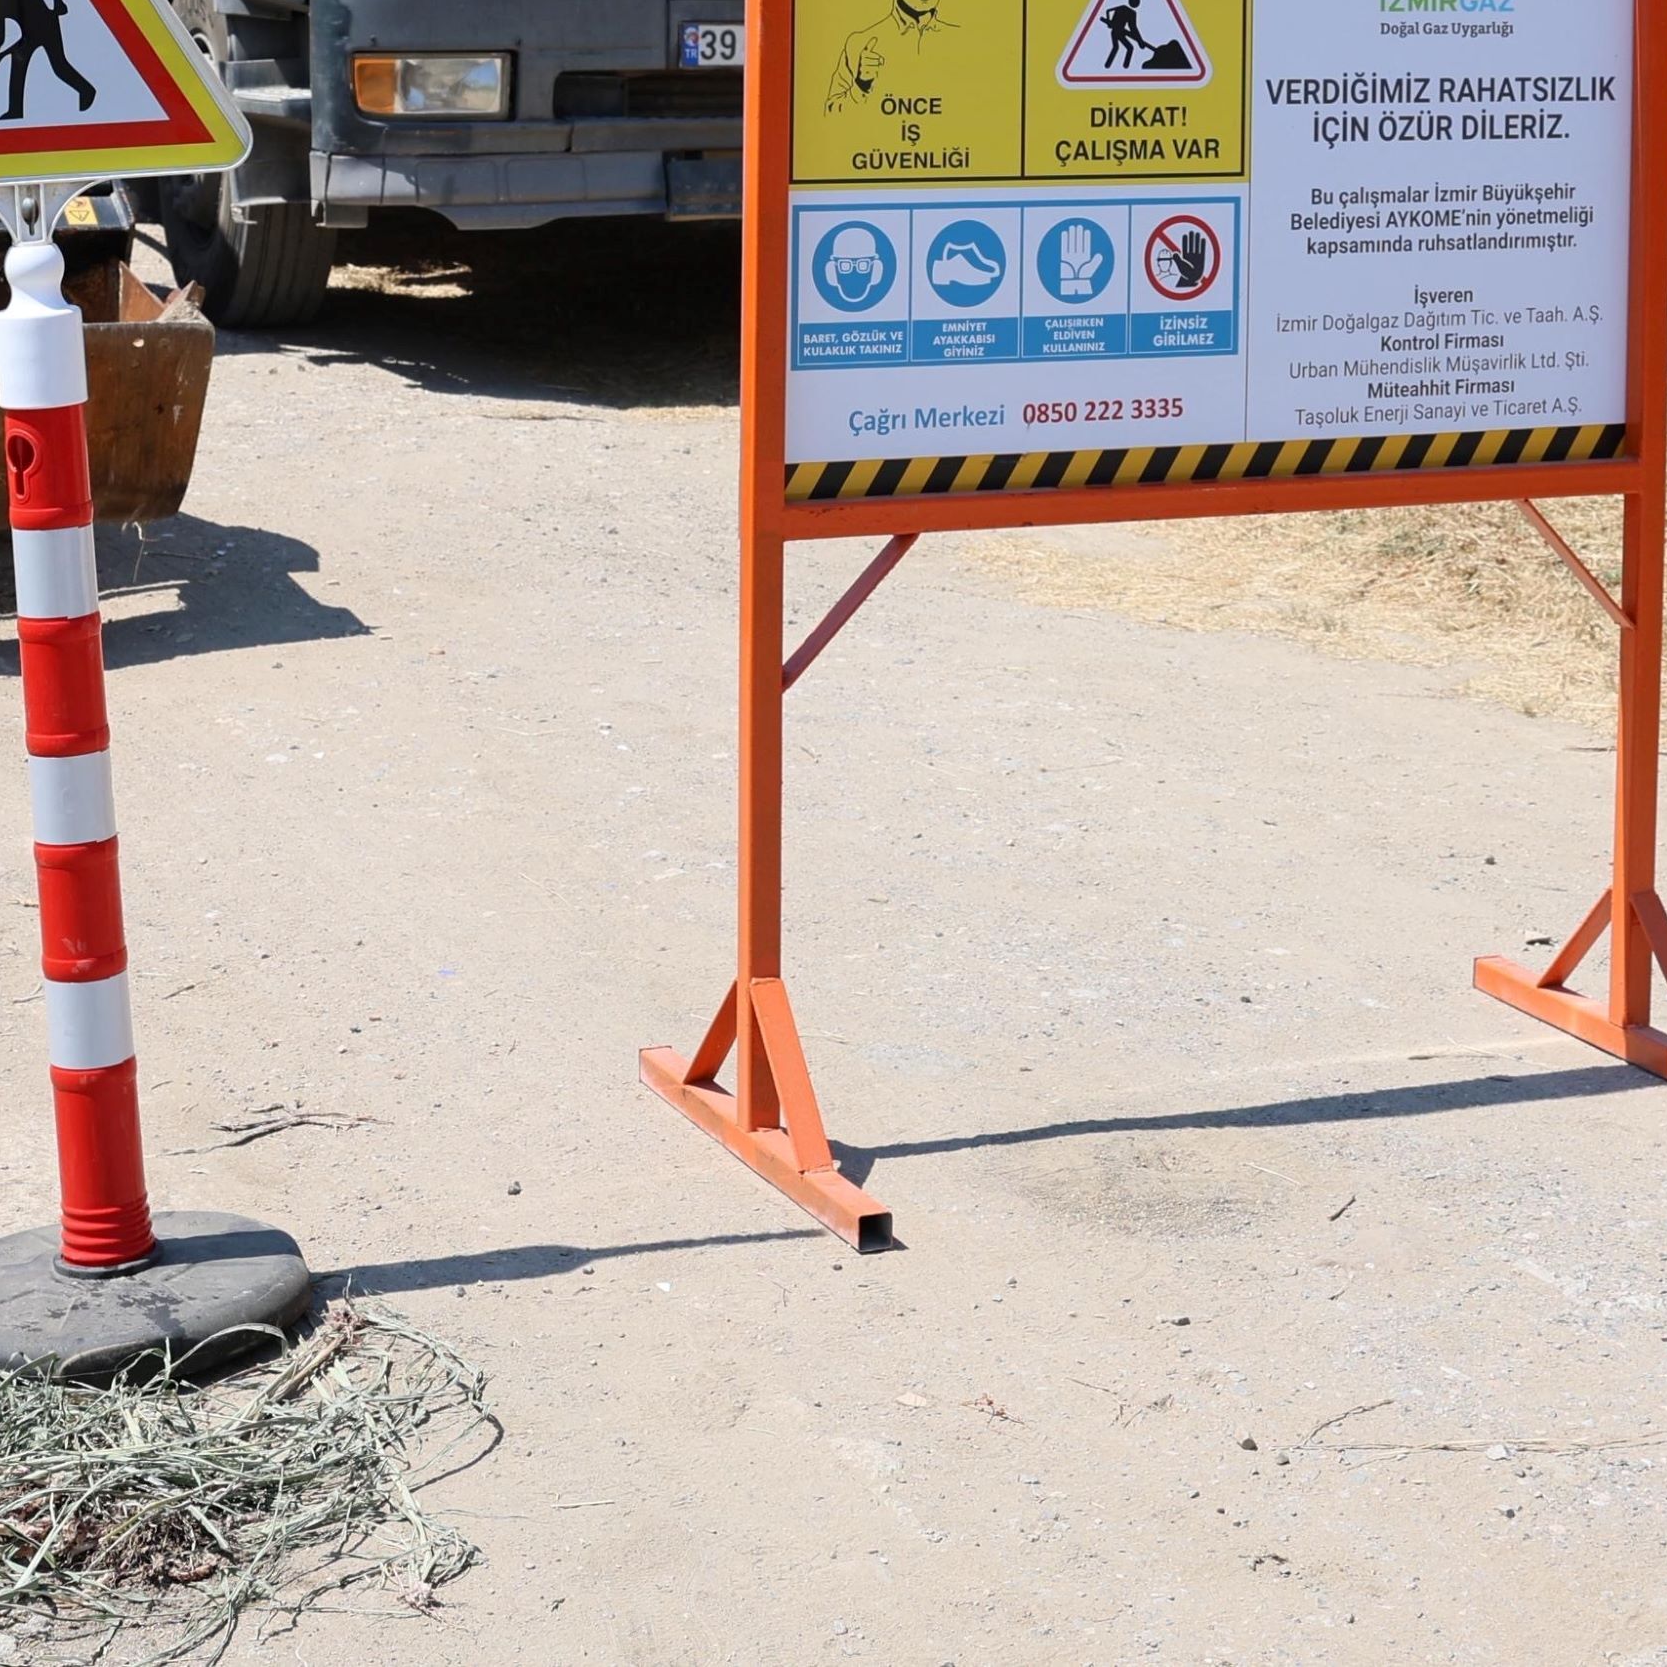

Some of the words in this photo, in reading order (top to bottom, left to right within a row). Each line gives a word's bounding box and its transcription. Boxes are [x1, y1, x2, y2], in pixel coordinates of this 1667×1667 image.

[1380, 21, 1420, 37] Doğal
[1423, 22, 1449, 35] Gaz
[1451, 22, 1514, 37] Uygarlığı
[685, 48, 698, 59] TR
[700, 30, 737, 61] 39
[1266, 72, 1430, 105] VERDİĞİMİZ
[1439, 76, 1616, 103] RAHATSIZLIK
[880, 93, 942, 116] ÖNCE
[1090, 102, 1188, 128] DİKKAT!
[901, 123, 921, 146] İŞ
[1313, 111, 1369, 149] İÇİN
[1379, 110, 1452, 141] ÖZÜR
[1462, 108, 1571, 140] DİLERİZ.
[852, 146, 970, 170] GÜVENLİĞİ
[1055, 140, 1166, 167] ÇALIŞMA
[1173, 138, 1220, 159] VAR
[1311, 188, 1334, 205] Bu
[1339, 187, 1429, 209] çalışmalar
[1434, 182, 1477, 203] İzmir
[1482, 184, 1576, 206] Büyükşehir
[1290, 212, 1380, 233] Belediyesi
[1496, 206, 1594, 231] yönetmeliği
[1306, 236, 1413, 259] kapsamında
[1418, 233, 1577, 253] ruhsatlandırımıştır.
[1414, 285, 1473, 309] İşveren
[942, 321, 987, 333] EMNİYET
[1045, 317, 1104, 330] ÇALIŞIRKEN
[1160, 314, 1208, 330] İZİNSİZ
[1276, 314, 1316, 332] İzmir
[1322, 313, 1399, 335] Doğalgaz
[1404, 310, 1466, 333] Dağıtım
[1471, 309, 1498, 326] Tic.
[1504, 311, 1522, 326] ve
[1527, 307, 1568, 324] Taah.
[1573, 306, 1603, 325] A.Ş.
[803, 334, 839, 347] BARET,
[842, 331, 887, 344] GÖZLÜK
[891, 331, 904, 342] VE
[933, 334, 996, 346] AYAKKABISI
[1053, 328, 1096, 340] ELDİVEN
[1153, 331, 1214, 347] GİRİLMEZ
[1381, 334, 1439, 353] Kontrol
[1444, 334, 1504, 349] Firması
[803, 345, 855, 356] KULAKLIK
[858, 343, 902, 354] TAKINIZ
[944, 345, 985, 358] GİYİNİZ
[1042, 340, 1105, 353] KULLANINIZ
[1290, 362, 1339, 379] Urban
[1344, 358, 1441, 377] Mühendislik
[1446, 354, 1527, 375] Müşavirlik
[1532, 353, 1560, 369] Ltd.
[1566, 351, 1589, 371] Şti.
[1368, 380, 1450, 399] Müteahhit
[1455, 379, 1515, 395] Firması
[849, 406, 907, 436] Çağrı
[914, 404, 1005, 429] Merkezi
[1023, 402, 1077, 425] 0850
[1084, 400, 1123, 422] 222
[1131, 397, 1183, 419] 3335
[1295, 408, 1359, 428] Taşoluk
[1364, 404, 1408, 423] Enerji
[1413, 403, 1466, 422] Sanayi
[1471, 404, 1488, 417] ve
[1493, 400, 1547, 416] Ticaret
[1552, 398, 1582, 417] A.Ş.
